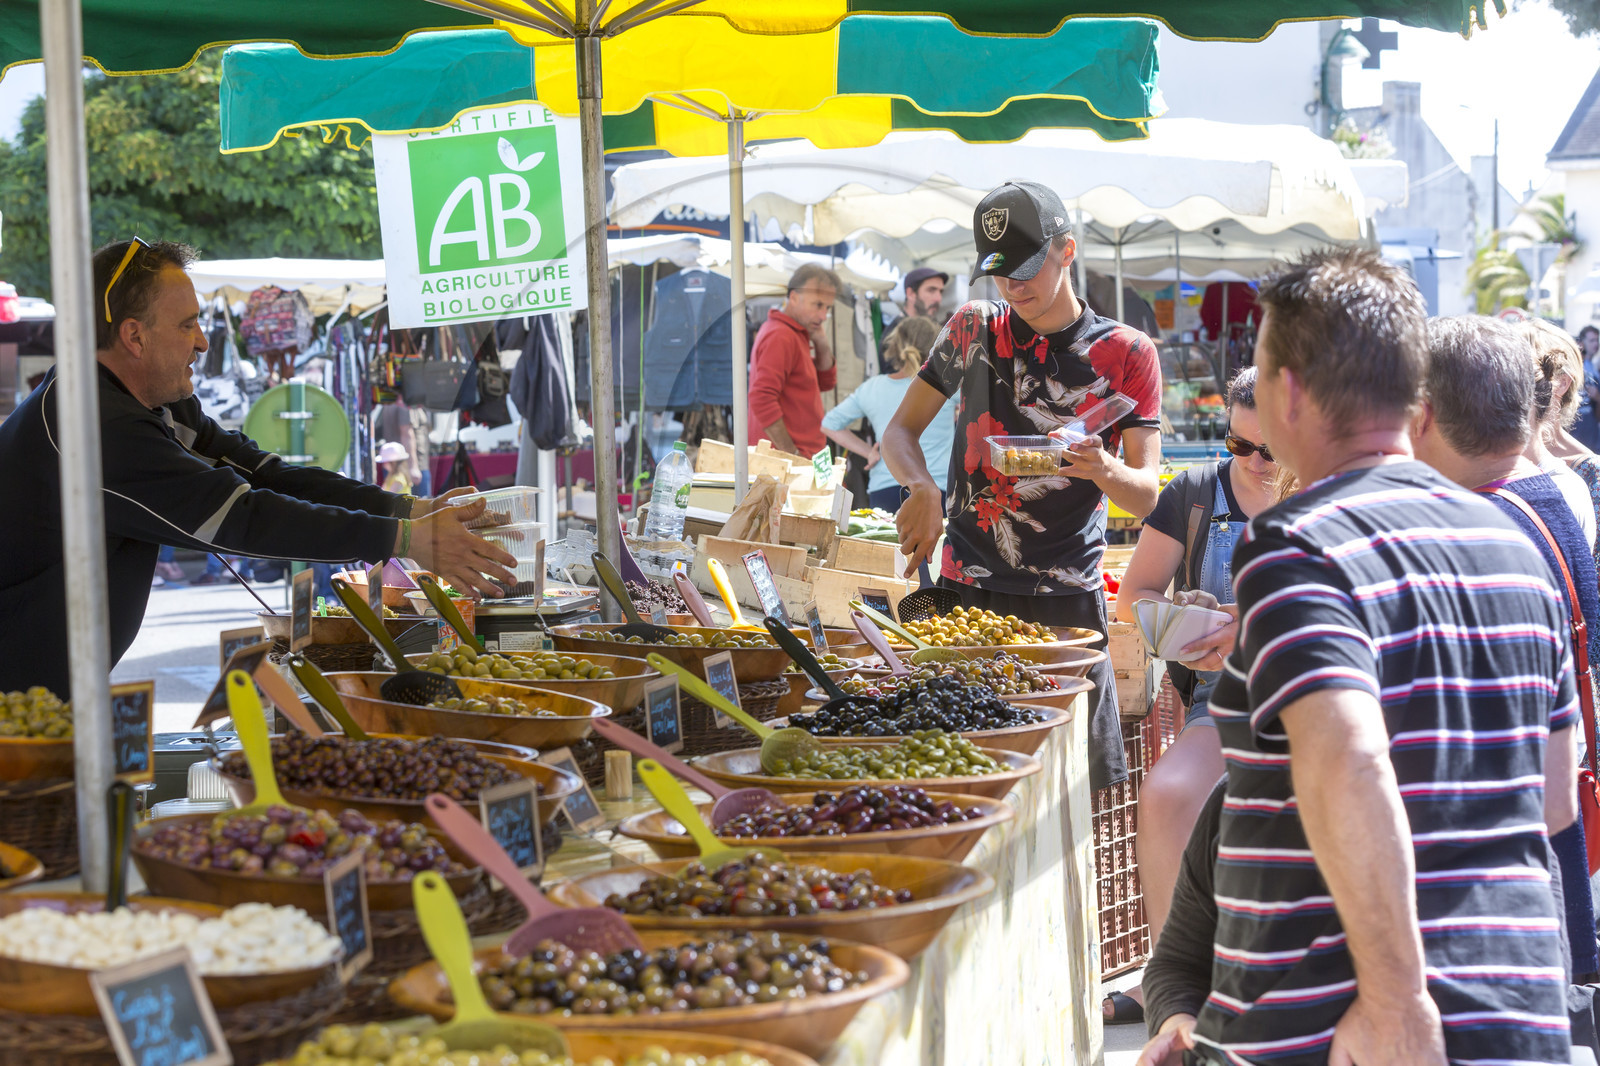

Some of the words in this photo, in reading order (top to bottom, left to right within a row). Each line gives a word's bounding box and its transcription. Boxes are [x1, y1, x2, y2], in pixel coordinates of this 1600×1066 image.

[429, 173, 541, 266] AB
[421, 264, 570, 295] AGRICULTURE
[424, 286, 572, 317] BIOLOGIQUE
